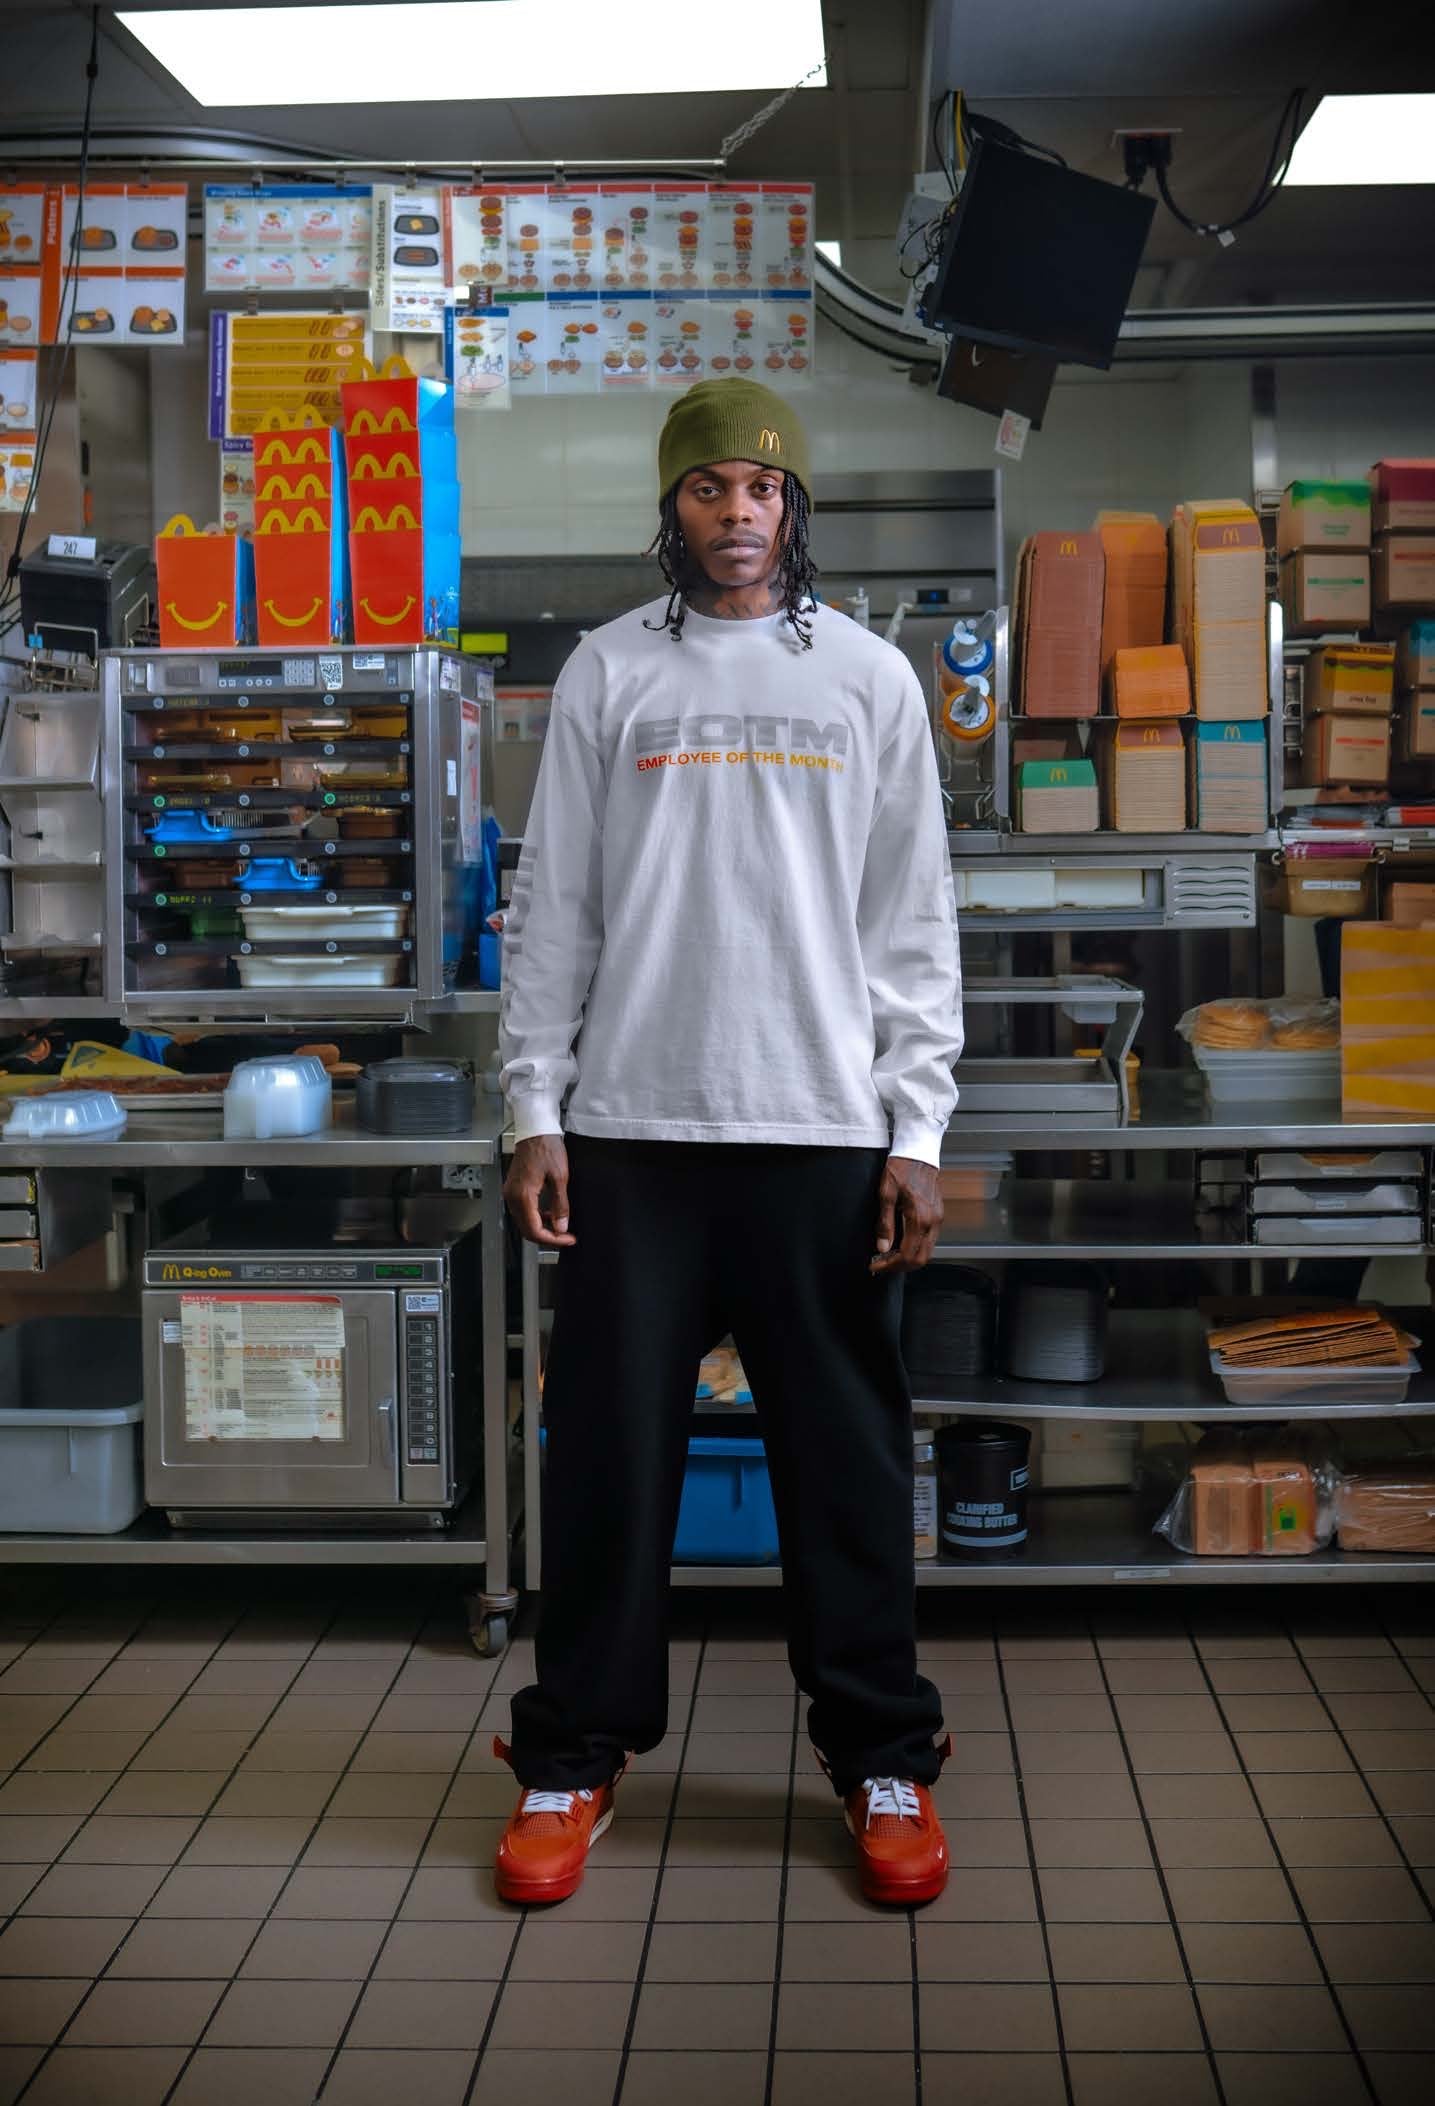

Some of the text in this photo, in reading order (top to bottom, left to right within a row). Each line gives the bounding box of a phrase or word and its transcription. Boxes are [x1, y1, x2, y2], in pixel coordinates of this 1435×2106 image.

[374, 200, 386, 307] Sides/Substitutions
[634, 714, 849, 754] EOTM
[636, 752, 844, 774] EMPLOYEE OF THE MONTH
